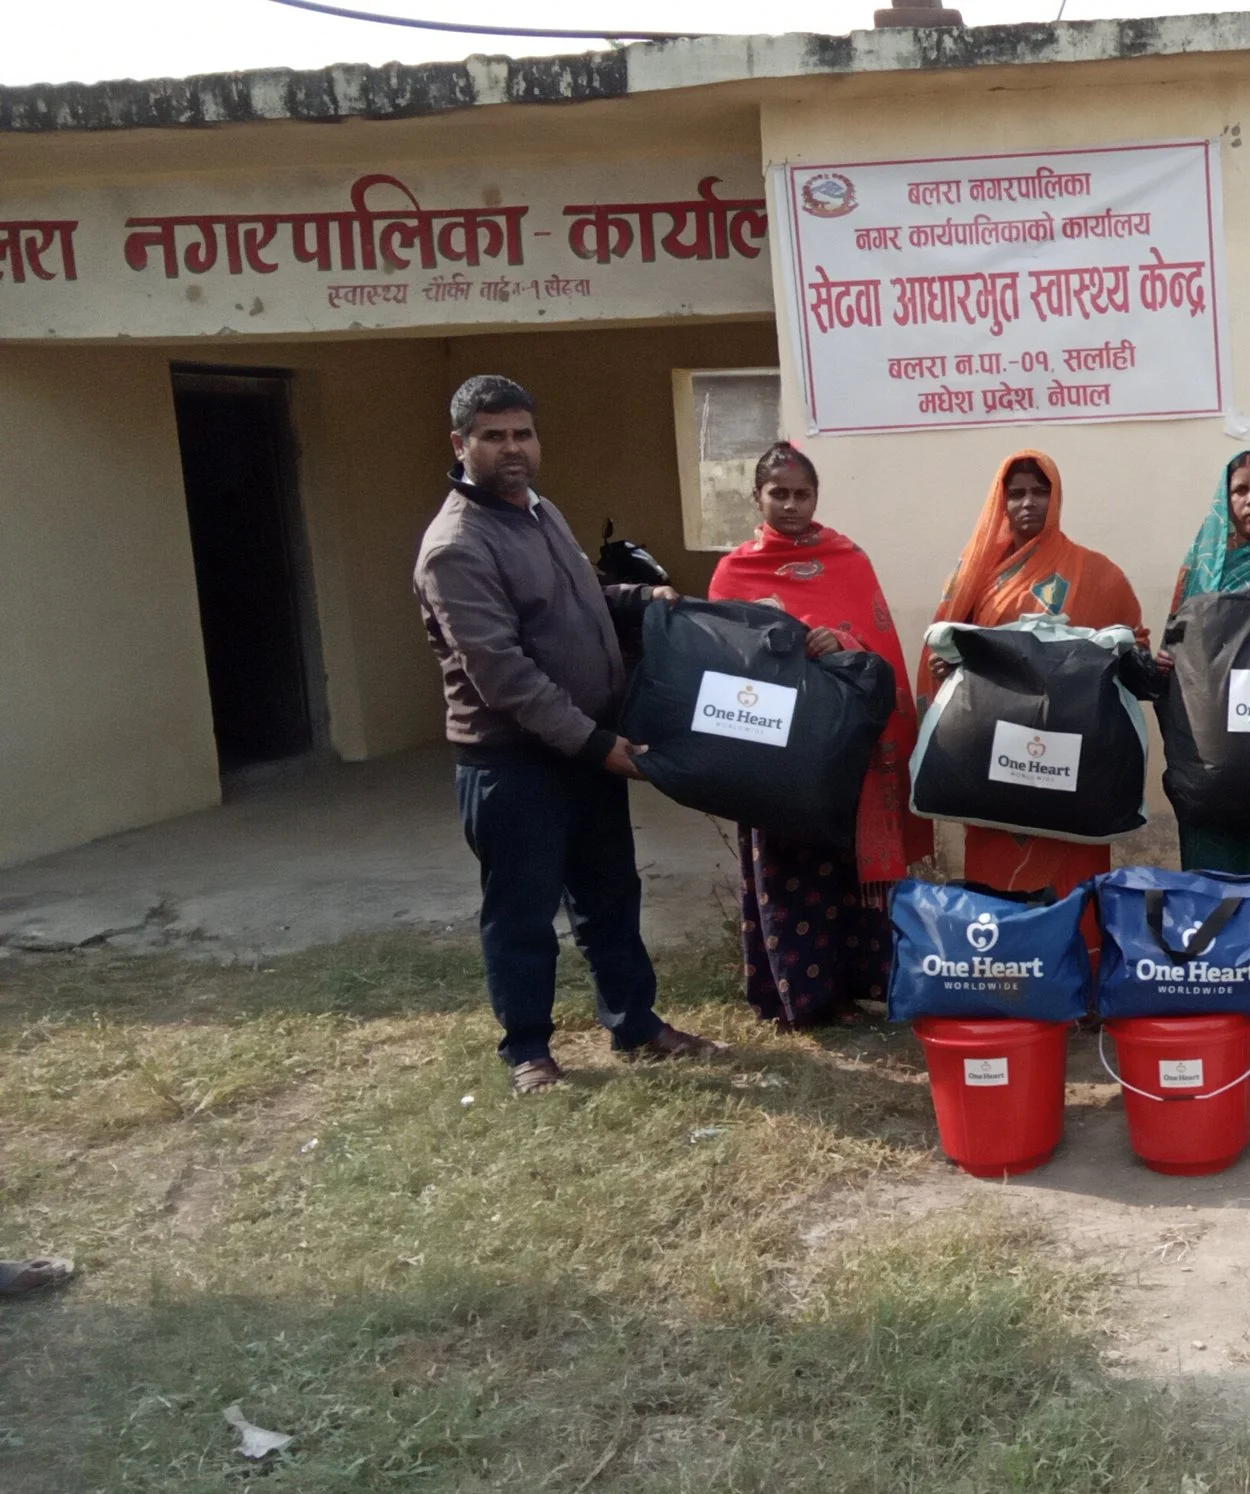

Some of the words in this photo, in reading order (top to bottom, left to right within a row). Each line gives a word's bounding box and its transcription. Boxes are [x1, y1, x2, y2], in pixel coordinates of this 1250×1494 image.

[907, 180, 961, 205] बलरा
[968, 166, 1091, 202] नगरपालिका
[124, 173, 529, 279] नगरपालिका
[854, 226, 903, 251] नगर
[908, 211, 1055, 248] कार्यपालिकाको
[1061, 208, 1151, 241] कार्यालय
[808, 265, 881, 334] सेढवा
[890, 272, 1020, 337] आधारभुत
[1028, 265, 1130, 322] स्वास्थ्य
[1138, 246, 1206, 317] केन्द्र
[888, 355, 947, 380] बलरा
[1062, 338, 1136, 373] सर्लाही
[918, 385, 974, 415] मधेश
[1047, 379, 1111, 408] नेपाल
[703, 704, 735, 721] One
[737, 709, 783, 730] Heart
[998, 755, 1026, 771] One
[1028, 760, 1071, 777] Heart
[922, 954, 969, 978] One
[971, 956, 1044, 979] Heart
[1136, 959, 1185, 982] One
[944, 981, 1019, 991] WORLDWIDE
[1157, 985, 1233, 995] WORLDWIDE
[968, 1072, 982, 1080] One
[983, 1072, 1004, 1080] Heart
[1163, 1073, 1177, 1081] One
[1178, 1073, 1200, 1081] Heart
